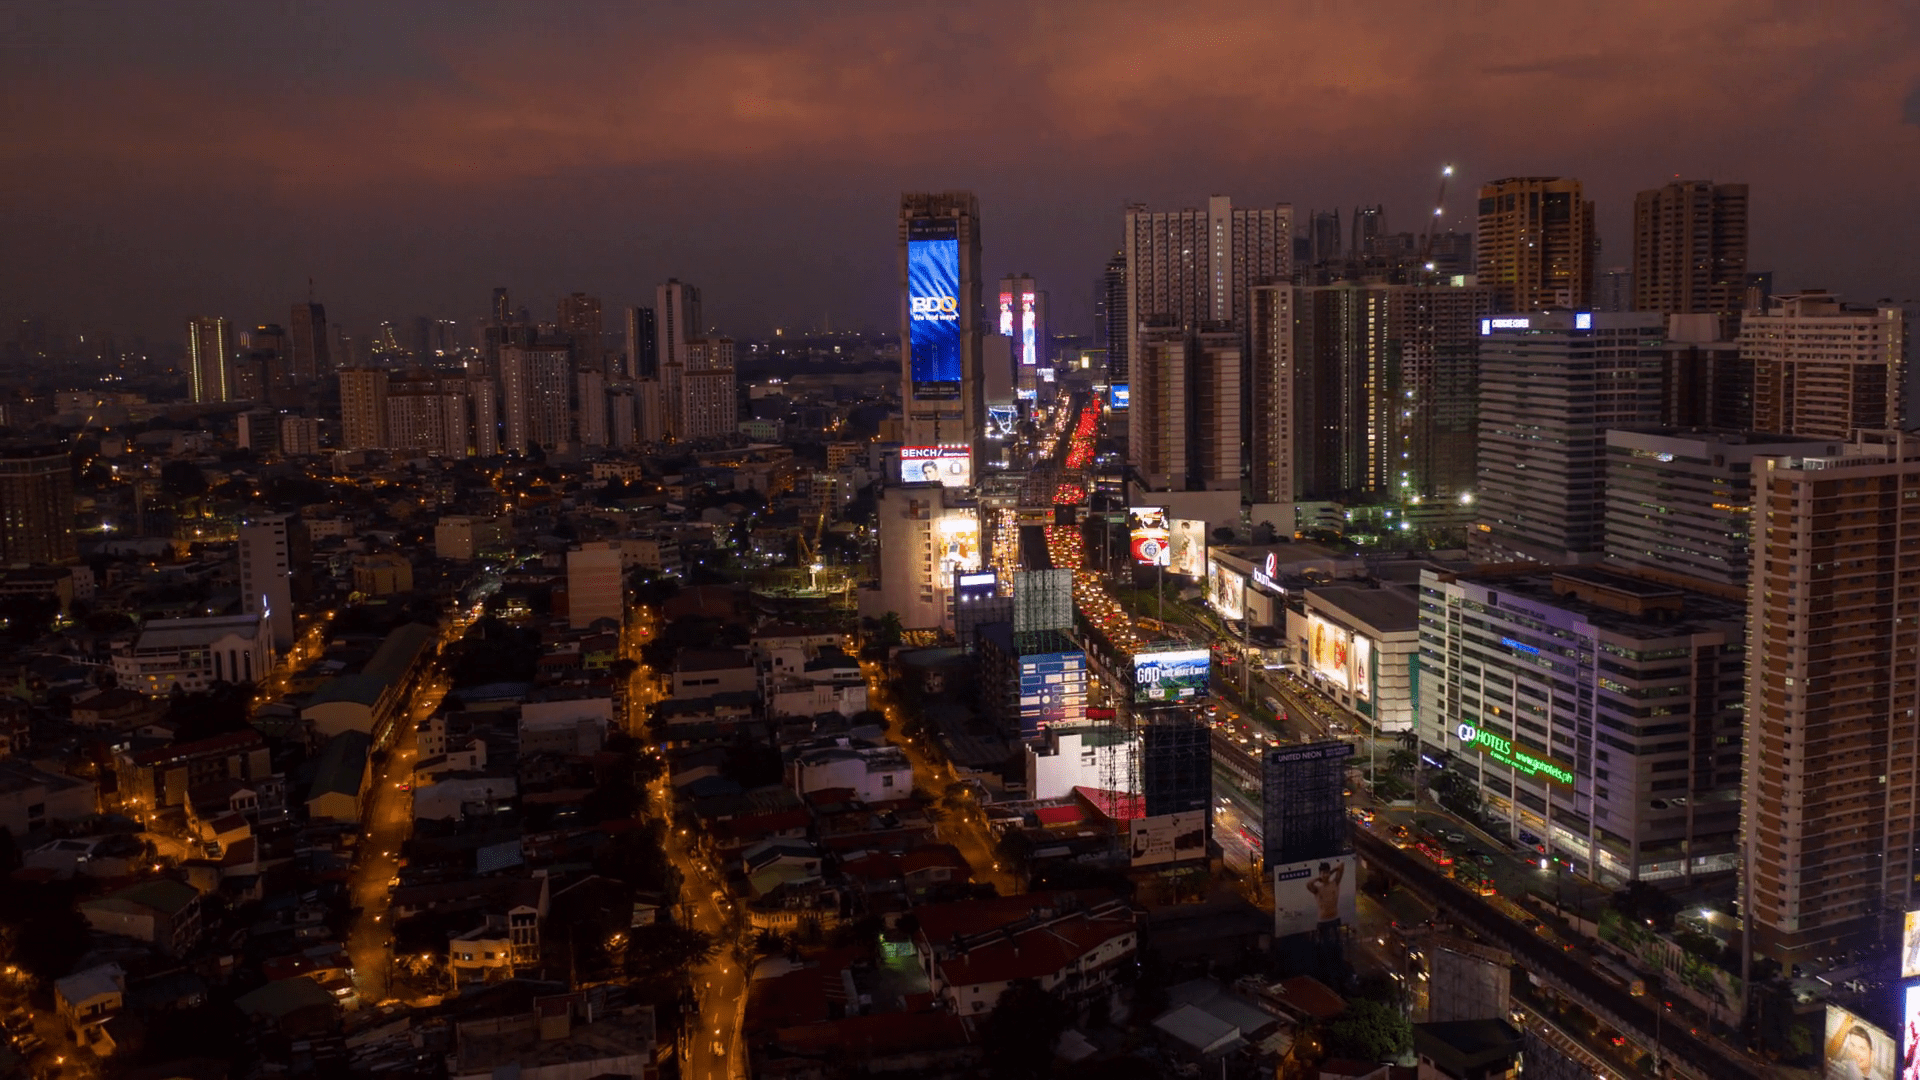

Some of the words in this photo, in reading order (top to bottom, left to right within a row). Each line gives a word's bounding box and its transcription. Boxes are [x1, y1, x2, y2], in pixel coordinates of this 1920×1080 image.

[912, 296, 957, 312] BDO
[1137, 667, 1160, 684] GOD
[1476, 729, 1511, 755] HOTELS
[1278, 753, 1301, 762] UNITED
[1302, 750, 1322, 760] NEON
[1515, 751, 1573, 784] www.gohotels.ph
